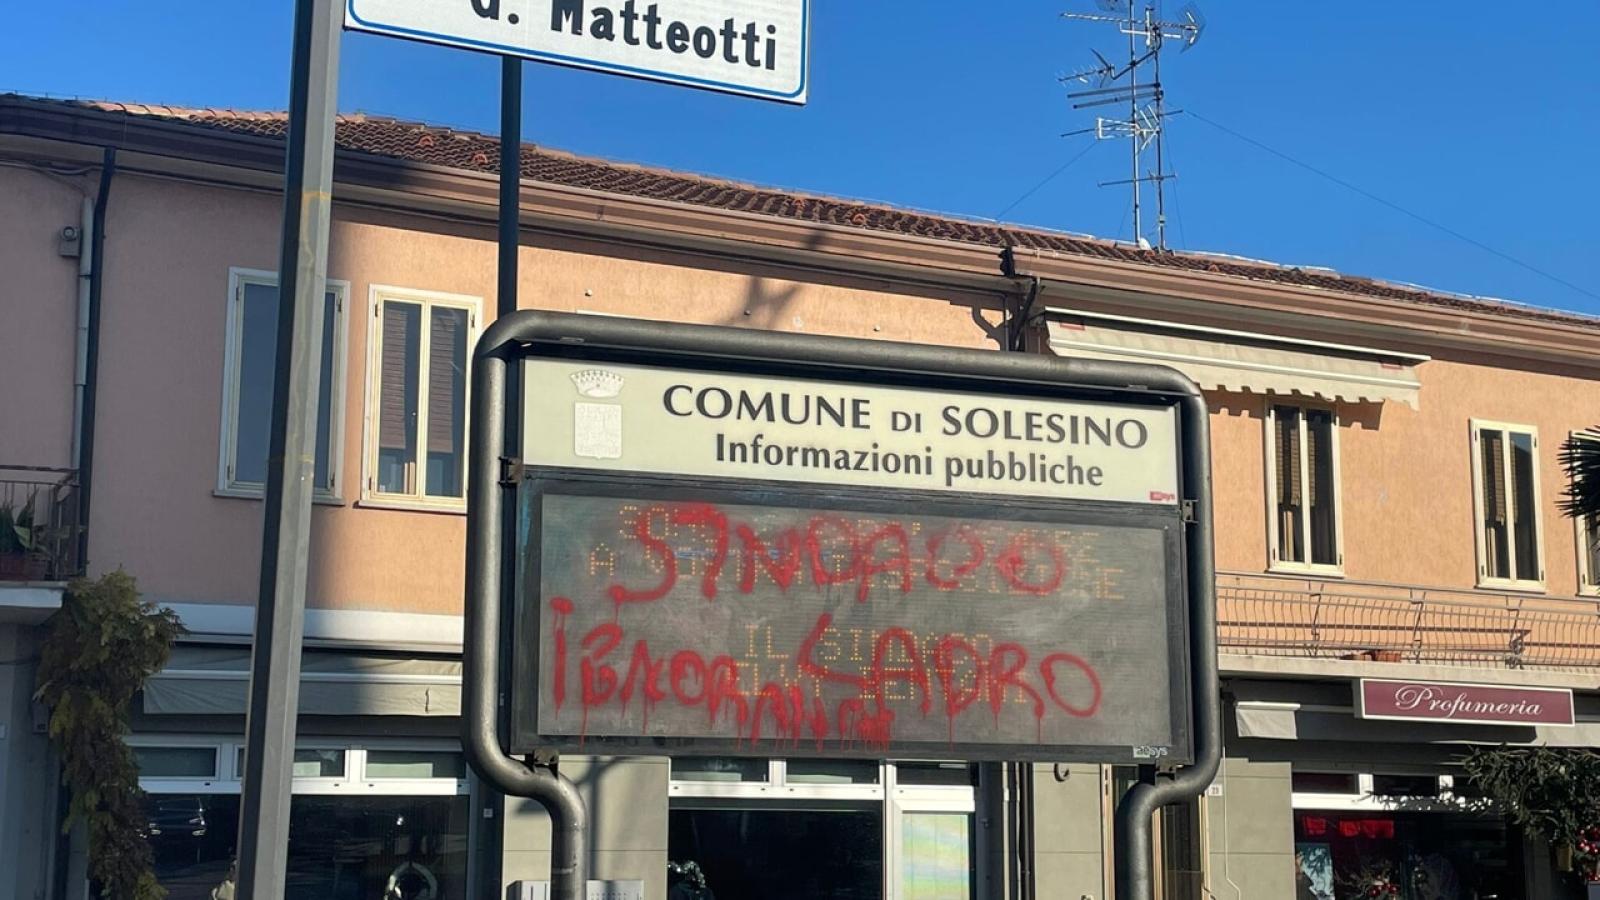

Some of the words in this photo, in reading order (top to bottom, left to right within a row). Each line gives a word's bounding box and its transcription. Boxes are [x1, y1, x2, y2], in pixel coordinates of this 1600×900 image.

[550, 0, 777, 71] Matteotti
[663, 384, 870, 430] COMUNE
[891, 410, 921, 434] DI
[942, 405, 1148, 450] SOLESINO
[716, 433, 932, 476] Informazioni
[945, 450, 1104, 487] pubbliche
[744, 623, 789, 658] IL
[1394, 684, 1544, 719] Profumeria
